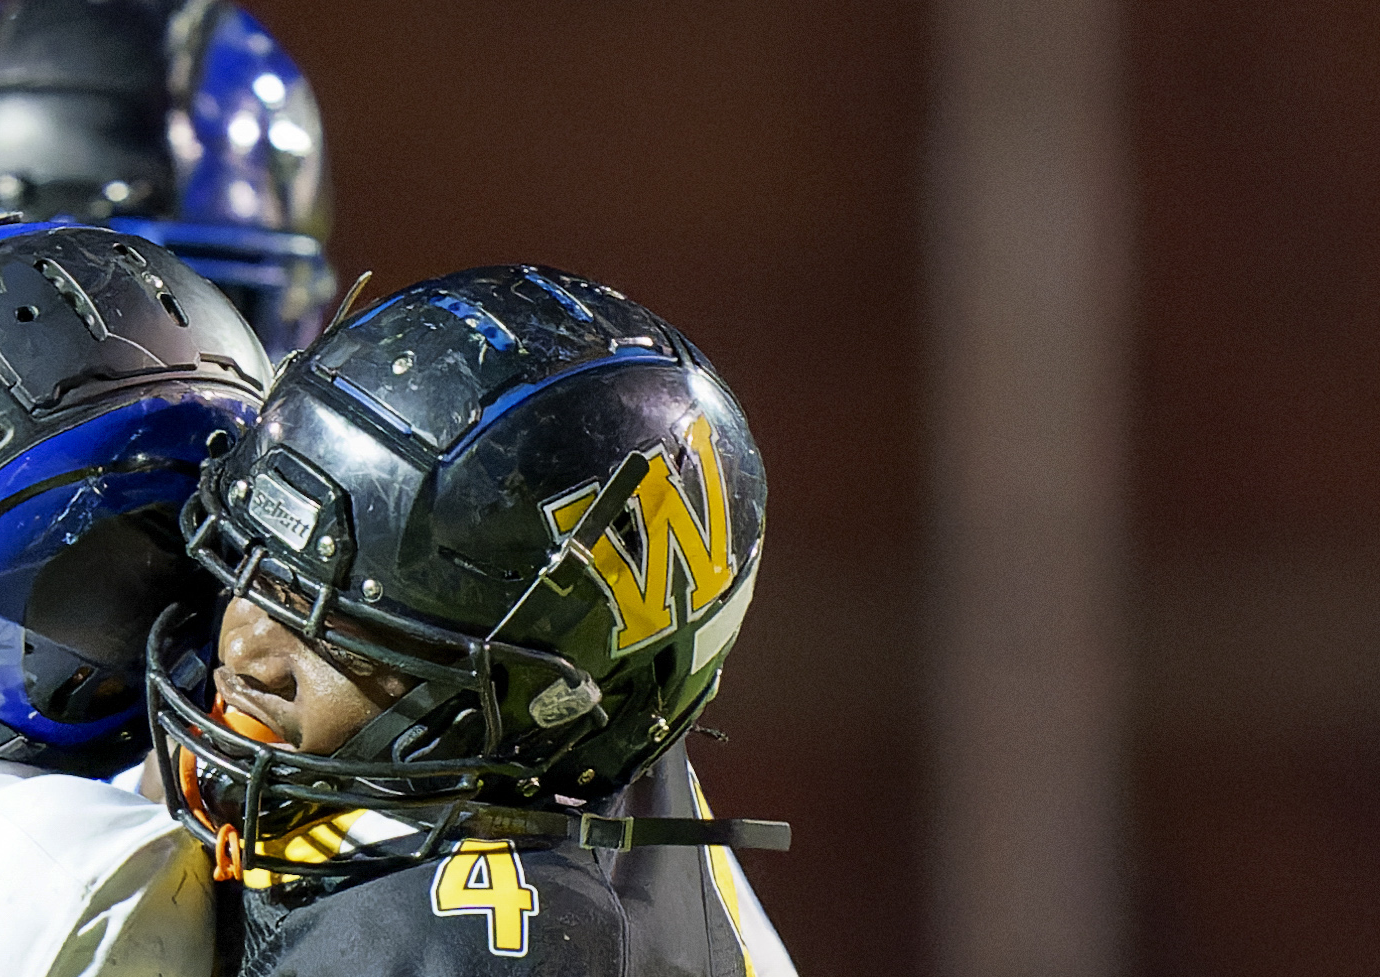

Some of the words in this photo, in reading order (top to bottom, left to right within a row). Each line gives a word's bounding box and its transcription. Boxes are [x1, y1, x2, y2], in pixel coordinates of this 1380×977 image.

[252, 493, 310, 539] schutt
[537, 402, 738, 660] W
[430, 838, 539, 958] 4
